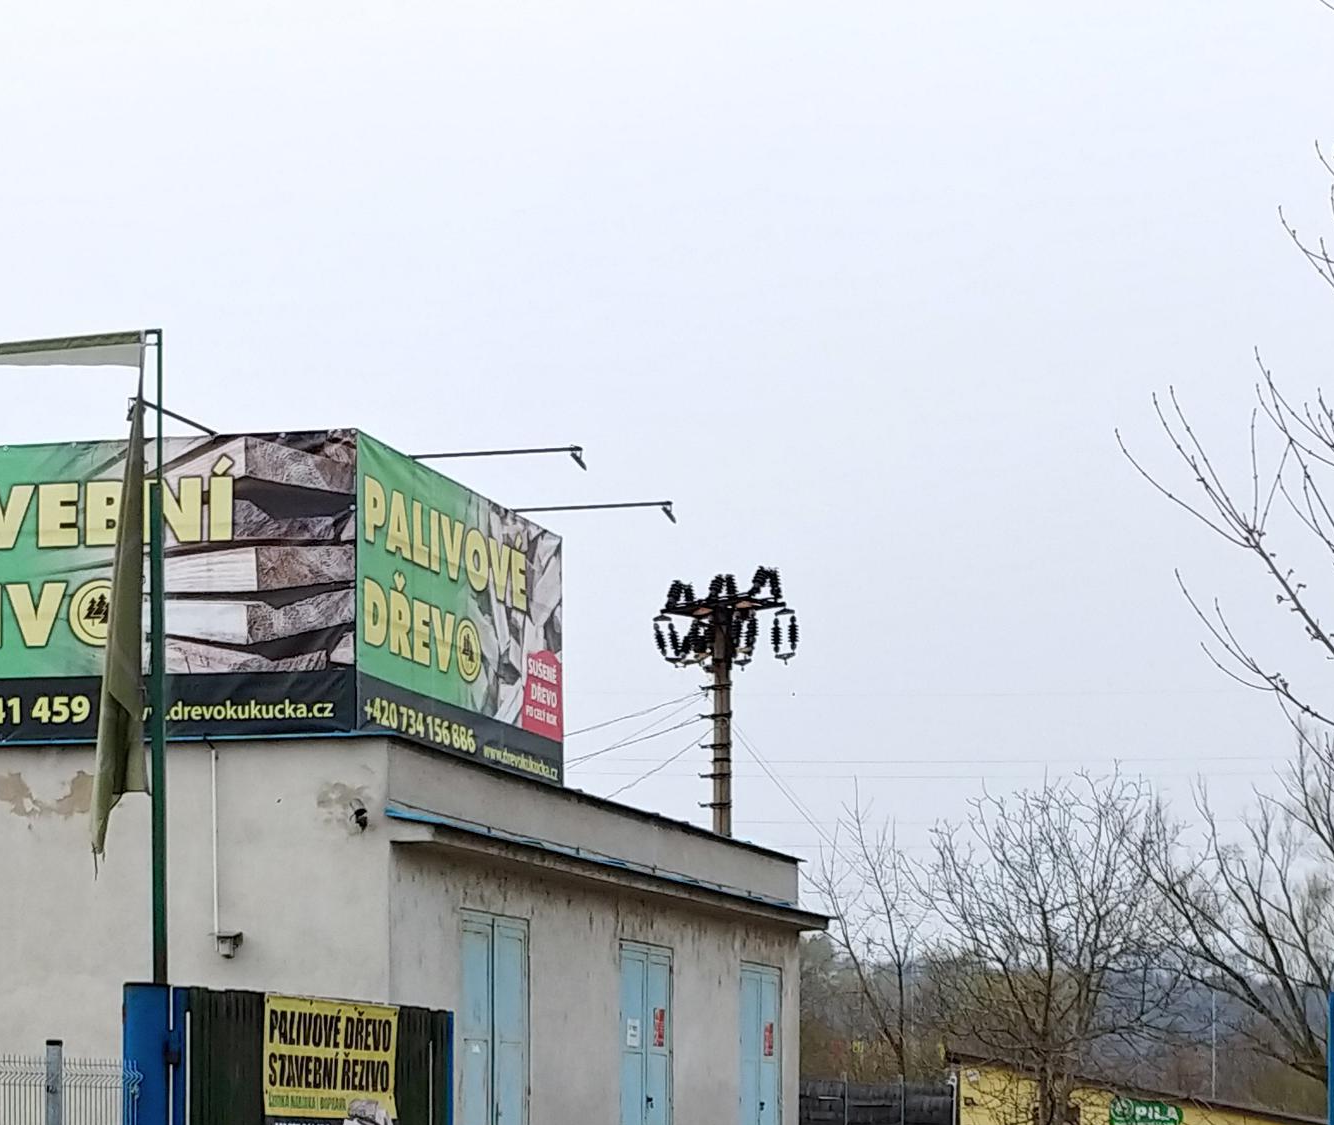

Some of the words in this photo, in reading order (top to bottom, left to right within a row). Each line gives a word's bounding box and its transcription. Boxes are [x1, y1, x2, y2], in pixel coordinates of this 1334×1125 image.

[364, 474, 527, 612] PALIVOVÉ
[364, 571, 482, 682] DŘEVO
[527, 656, 557, 685] SUŠENÉ
[32, 695, 91, 724] 459
[531, 682, 558, 708] DŘEVO
[364, 696, 397, 730] +420
[398, 705, 425, 739] 734
[426, 715, 452, 747] 156
[451, 723, 477, 754] 886
[269, 1008, 341, 1049] PALIVOVÉ
[344, 1010, 392, 1052] DŘEVO
[268, 1051, 339, 1091] STAVEBNÍ
[341, 1051, 390, 1093] ŘEZIVO
[1135, 1105, 1179, 1121] PILA
